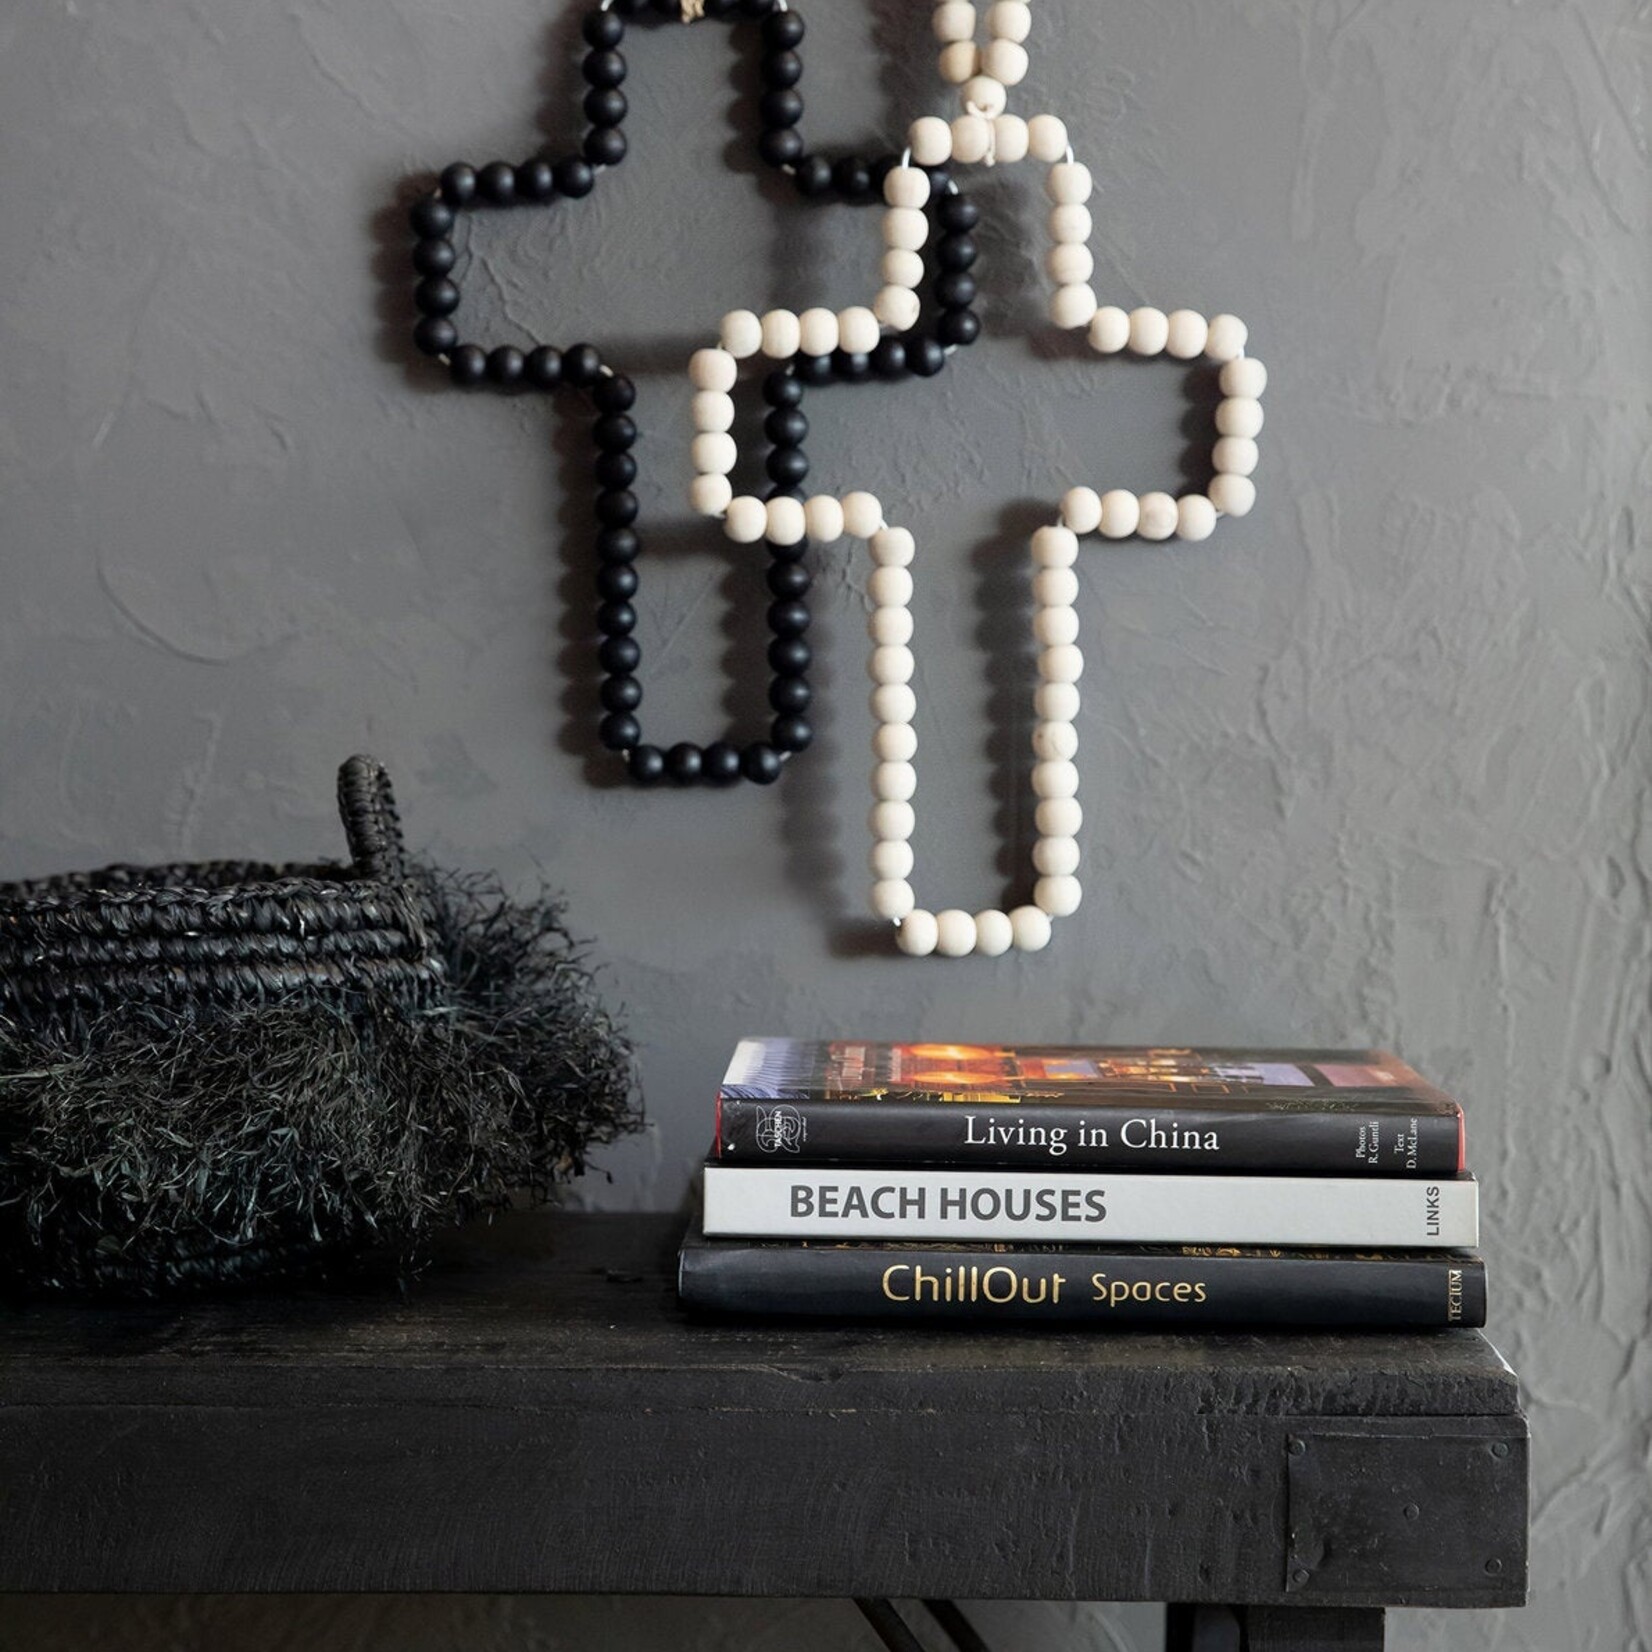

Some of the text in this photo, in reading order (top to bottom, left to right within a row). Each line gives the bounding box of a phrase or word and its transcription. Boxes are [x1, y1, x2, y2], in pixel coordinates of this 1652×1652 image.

[964, 1115, 1220, 1156] Living in China
[1355, 1126, 1367, 1158] Photos
[1393, 1133, 1405, 1154] Text
[790, 1185, 1107, 1222] BEACH HOUSES
[1426, 1186, 1440, 1236] LINKS
[882, 1264, 1207, 1307] ChillOut Spaces
